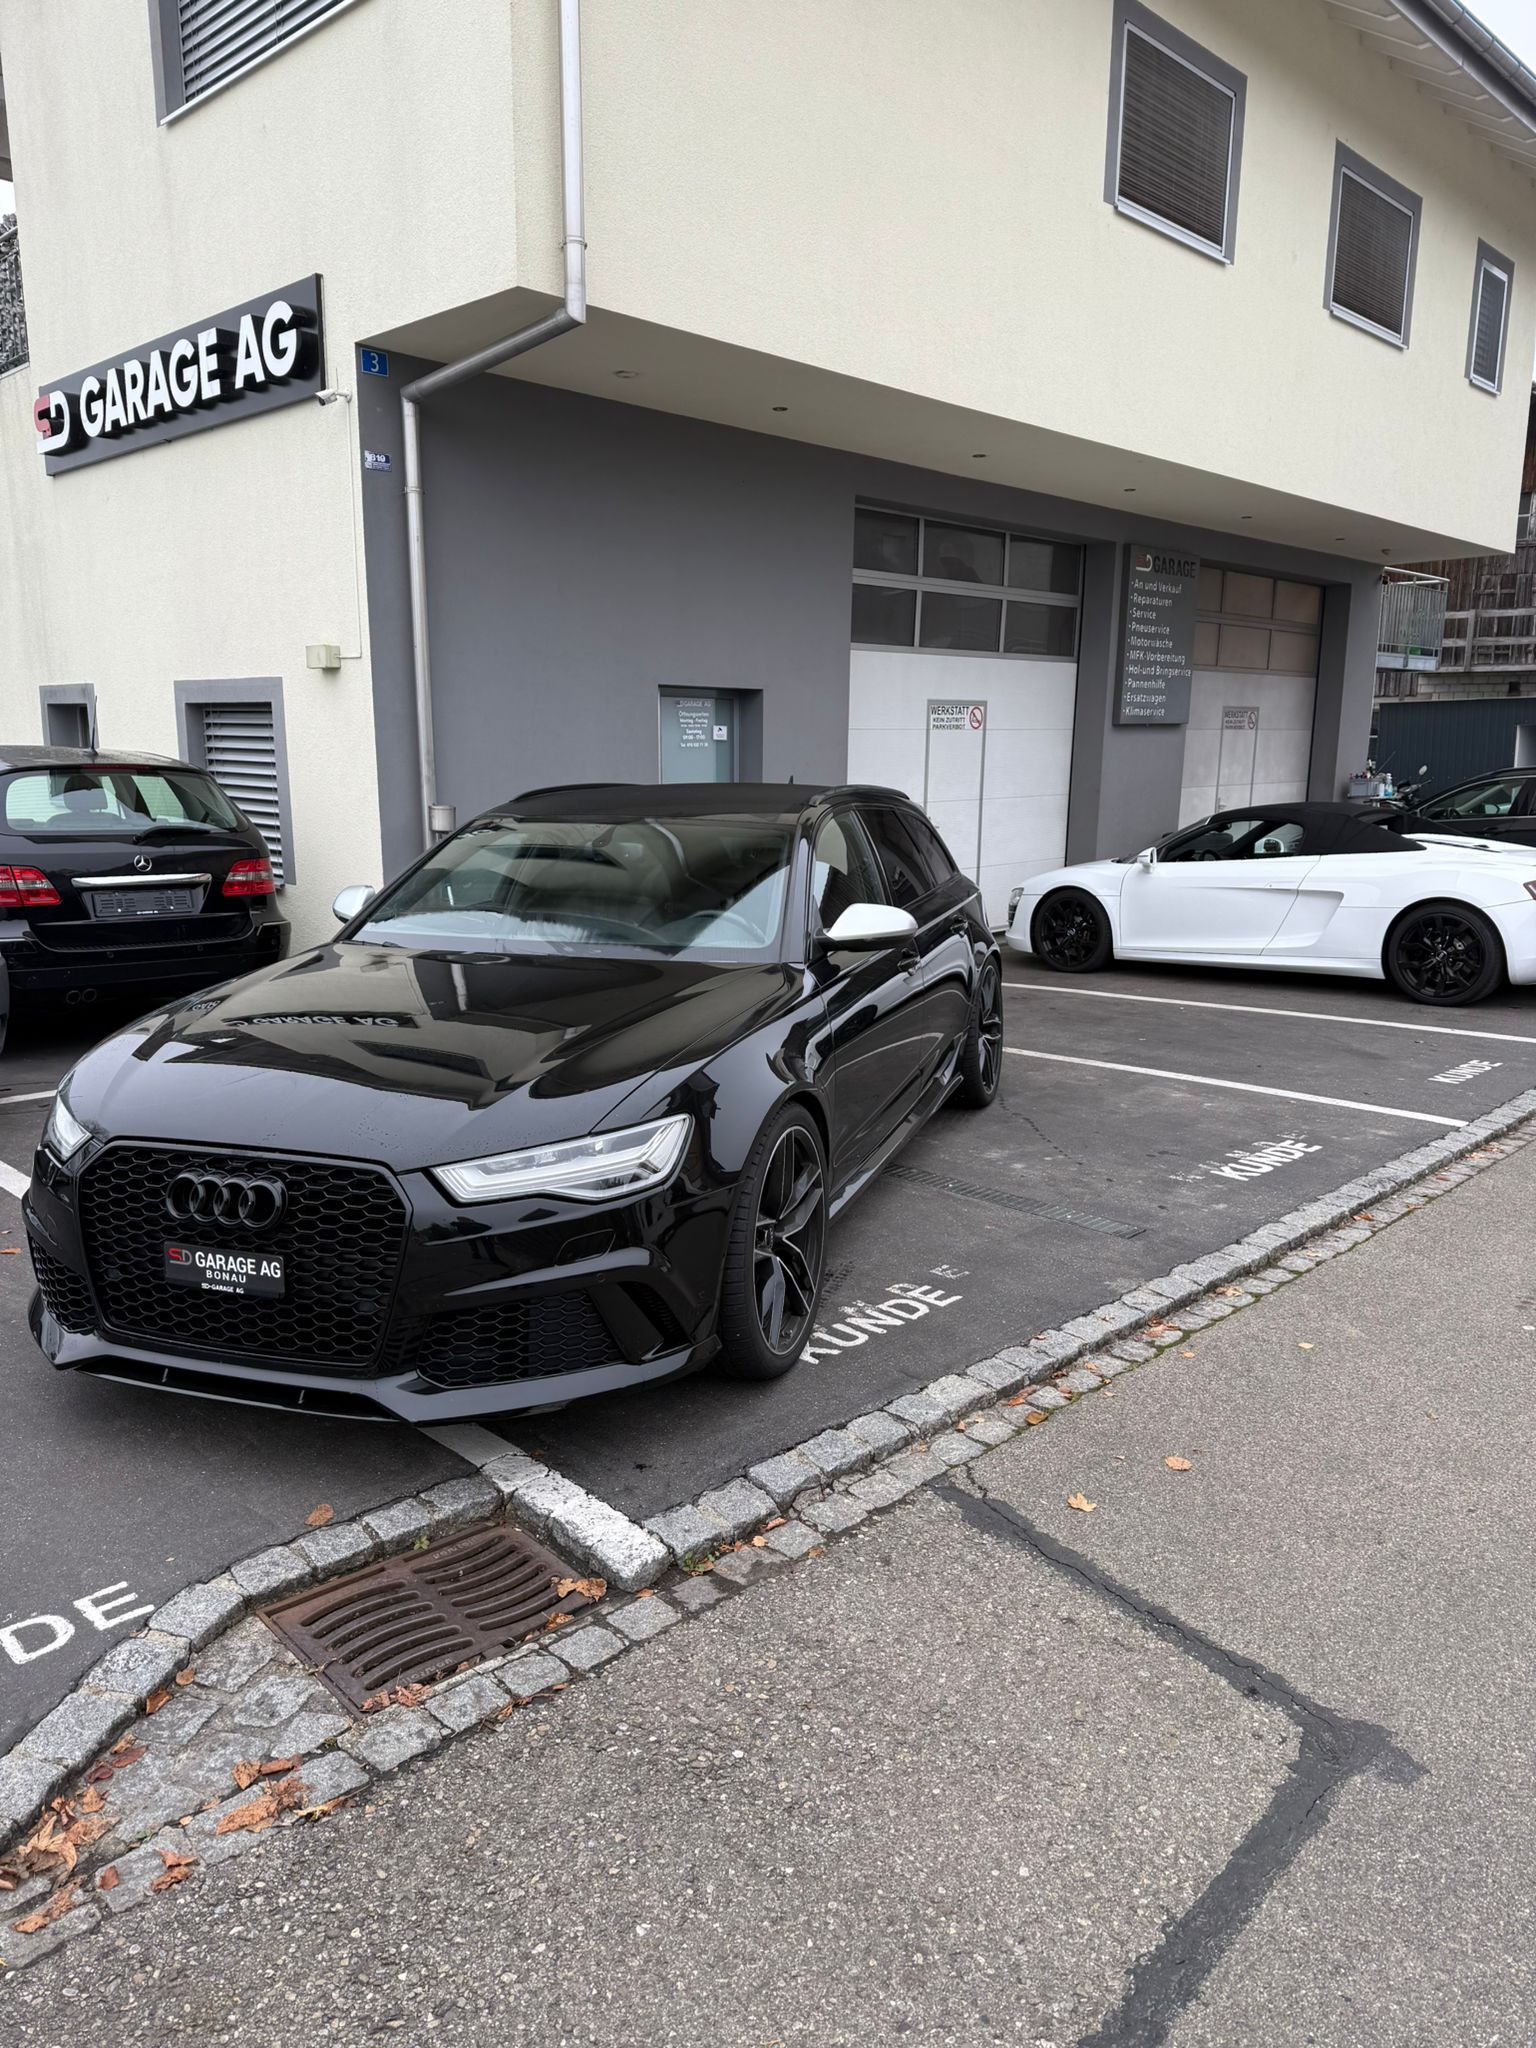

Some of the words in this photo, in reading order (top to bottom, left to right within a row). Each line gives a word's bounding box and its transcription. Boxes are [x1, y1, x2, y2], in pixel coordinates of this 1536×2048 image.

[80, 327, 221, 438] GARAGE
[235, 300, 298, 390] AG
[369, 352, 380, 373] 3
[1153, 556, 1197, 579] GARAGE
[1133, 579, 1144, 589] An
[1144, 581, 1158, 592] und
[1158, 582, 1182, 594] Verkauf
[1133, 593, 1173, 607] Reparaturen
[1132, 608, 1157, 620] Service
[1131, 622, 1170, 635] Pneuservice
[1130, 635, 1173, 649] Motorwäsche
[1129, 650, 1186, 666] MFK-Vorbereitung
[1155, 665, 1192, 679] Bringservice
[1127, 678, 1166, 689] Pannenhilfe
[1126, 692, 1167, 705] Ersatzwagen
[931, 706, 969, 715] WERKSTATT
[1125, 706, 1165, 717] Klimaservice
[1427, 1060, 1504, 1085] KUNDE
[1210, 1139, 1324, 1182] KUNDE
[195, 1251, 257, 1275] GARAGE
[259, 1260, 281, 1278] AG
[205, 1269, 247, 1283] BONAU
